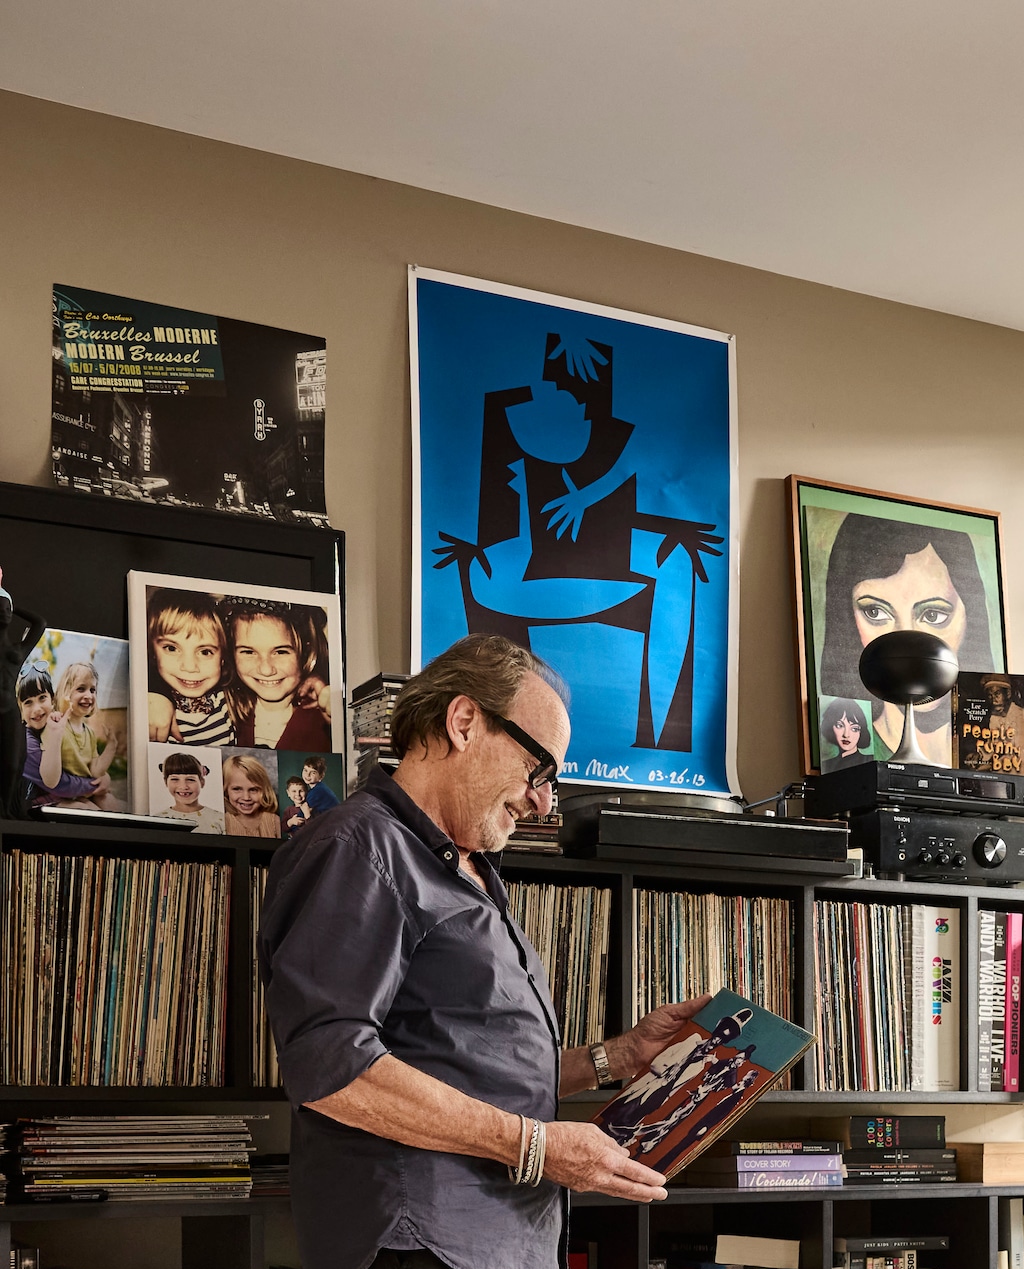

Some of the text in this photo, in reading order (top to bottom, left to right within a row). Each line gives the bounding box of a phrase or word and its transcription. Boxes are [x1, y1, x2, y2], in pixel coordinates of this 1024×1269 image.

[85, 313, 99, 321] Cas
[63, 323, 218, 345] Bruxelles MODERNE
[65, 343, 200, 363] MODERN Brussel
[69, 363, 92, 374] 15/07
[100, 364, 140, 375] 5/9/2008
[71, 376, 88, 385] GARE
[89, 377, 143, 387] CONGRESSTATION
[585, 758, 634, 782] Max
[942, 958, 952, 1003] JAZZ
[979, 913, 995, 1025] ANDY WARHOL
[932, 956, 942, 1025] COVERS
[991, 960, 1006, 1064] WARHOL LIVE
[1011, 976, 1020, 1055] POPPIONIERS
[867, 1121, 875, 1145] 1000
[876, 1118, 884, 1148] Record
[744, 1160, 791, 1168] COVER STORY
[749, 1172, 817, 1187] ¡Cocinando!
